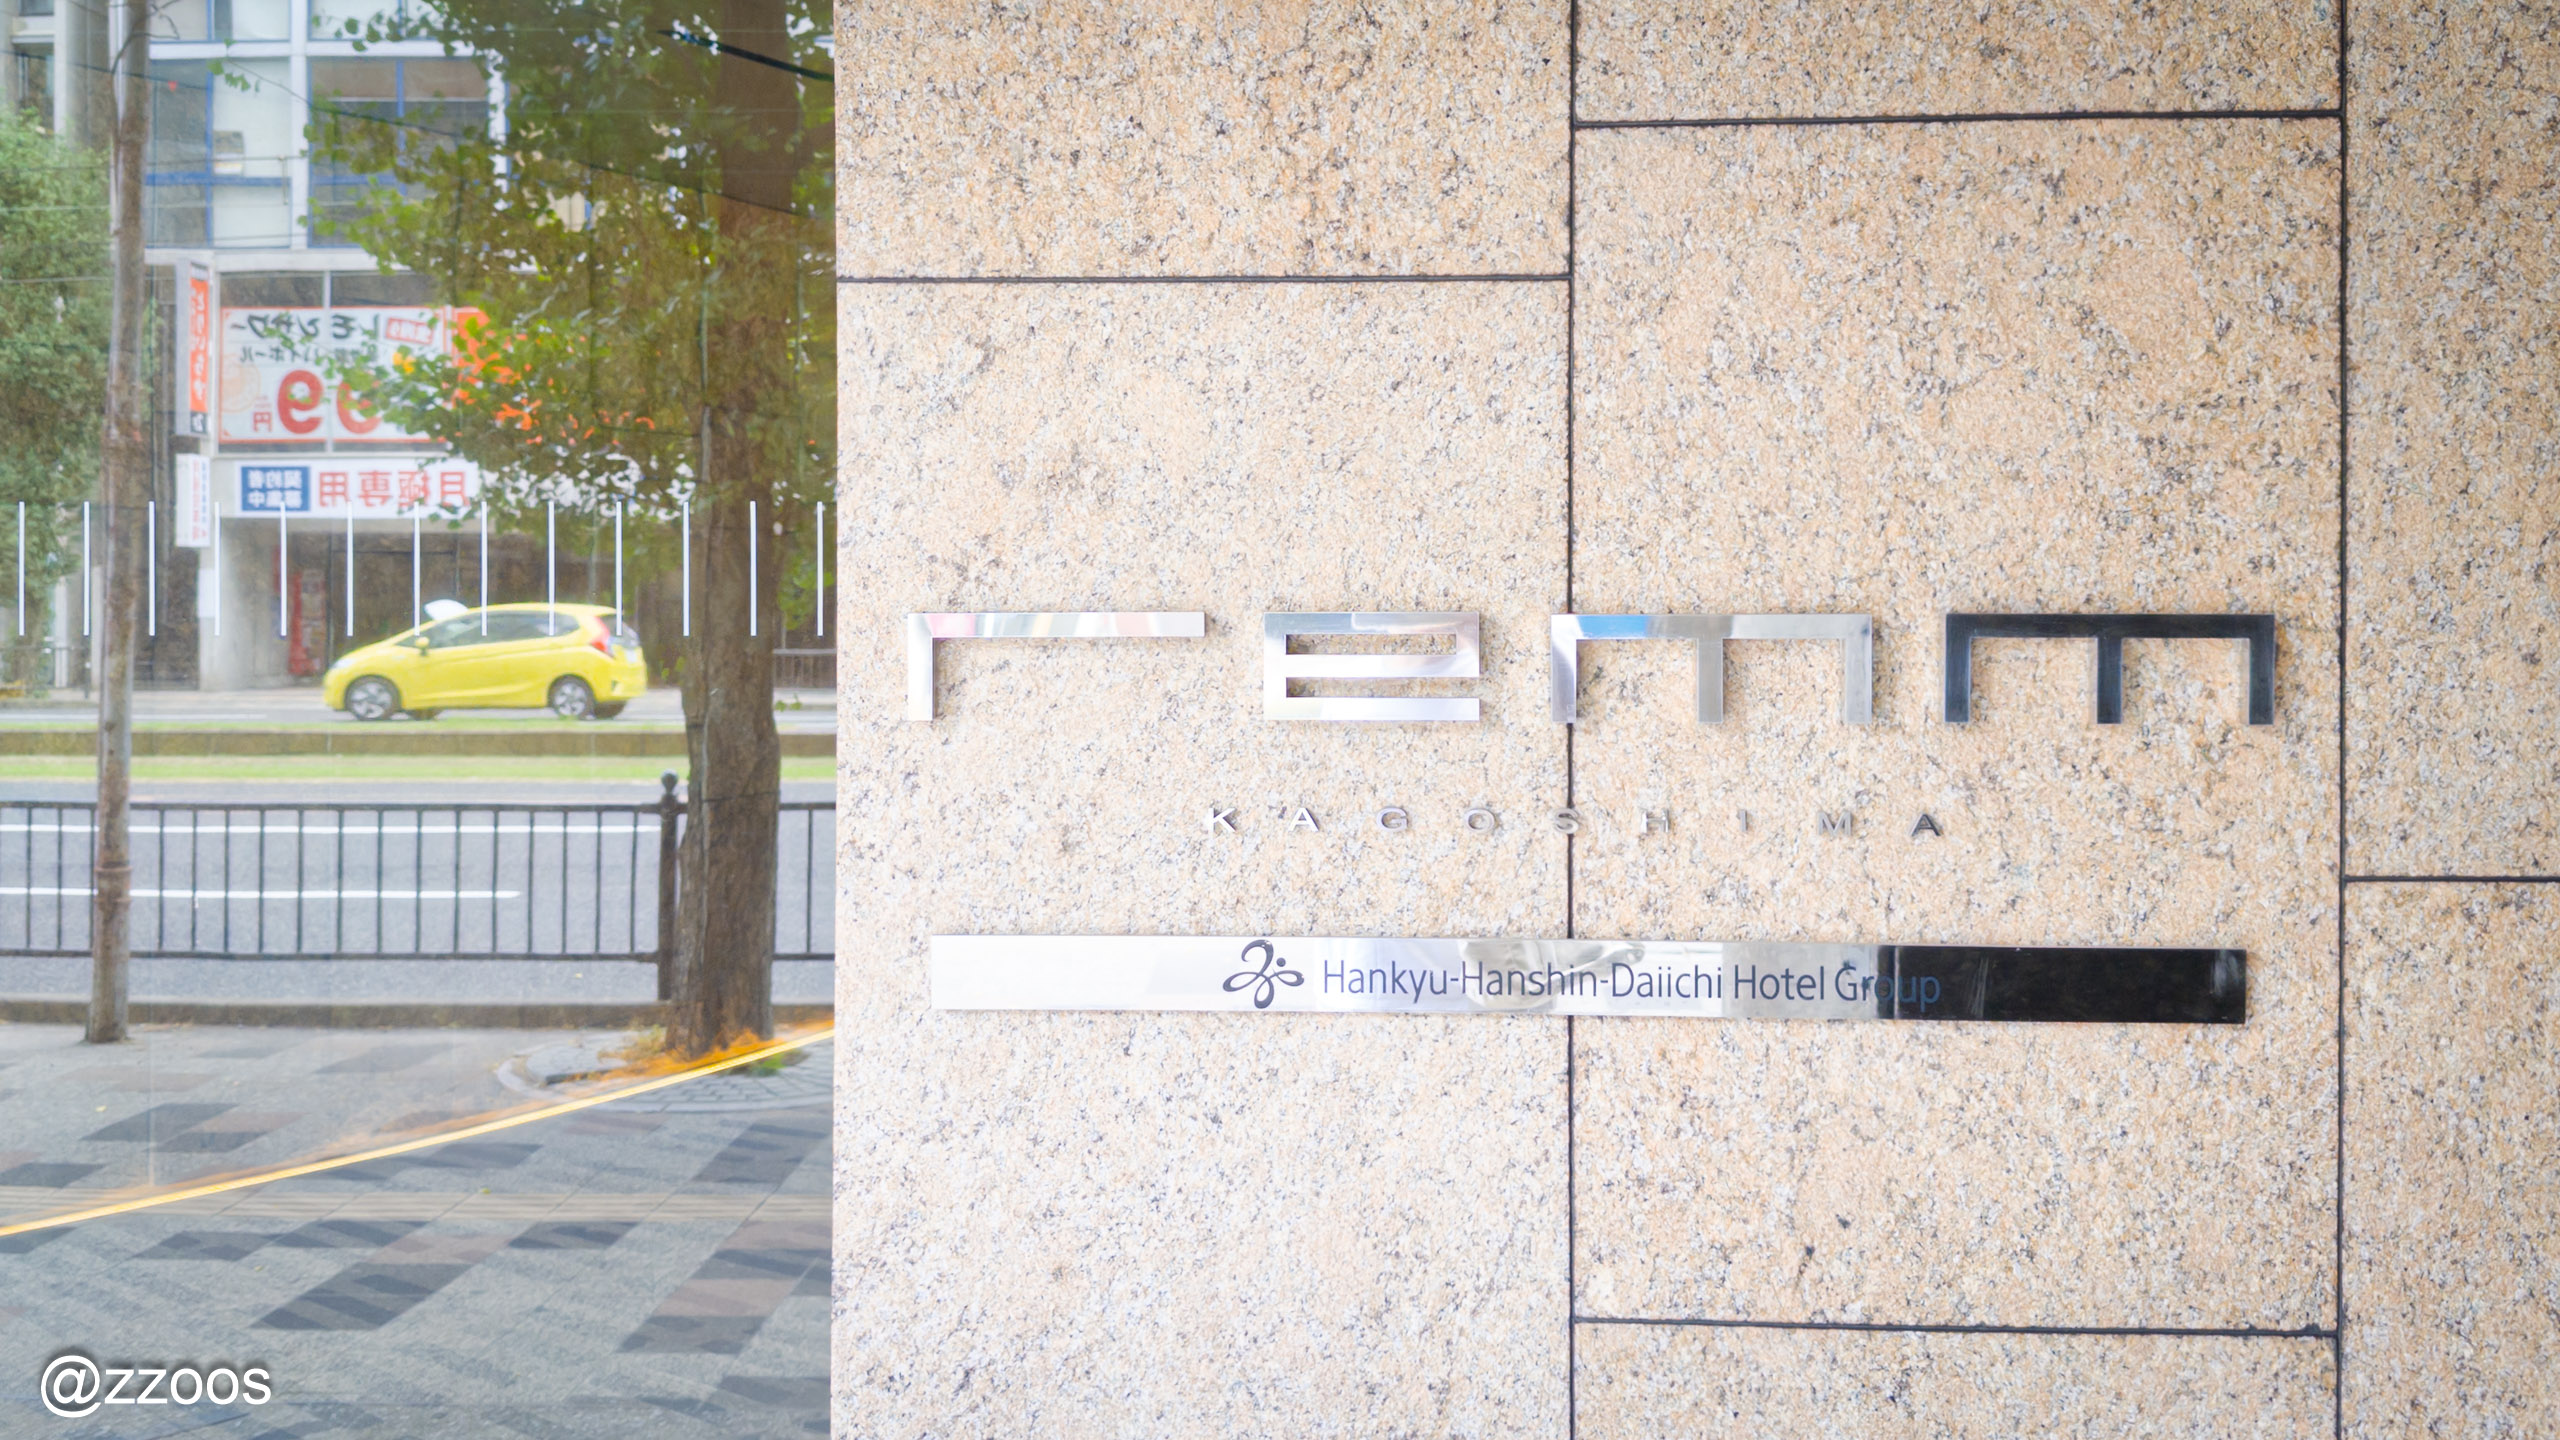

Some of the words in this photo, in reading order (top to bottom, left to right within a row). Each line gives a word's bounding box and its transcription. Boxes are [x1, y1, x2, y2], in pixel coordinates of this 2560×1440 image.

[907, 611, 2275, 725] remm
[1206, 806, 1942, 837] KAGOSHIMA
[1323, 960, 1722, 1004] Hankyu-Hanshin-Daiichi
[1734, 963, 1826, 1000] Hotel
[1834, 965, 1942, 1012] Group
